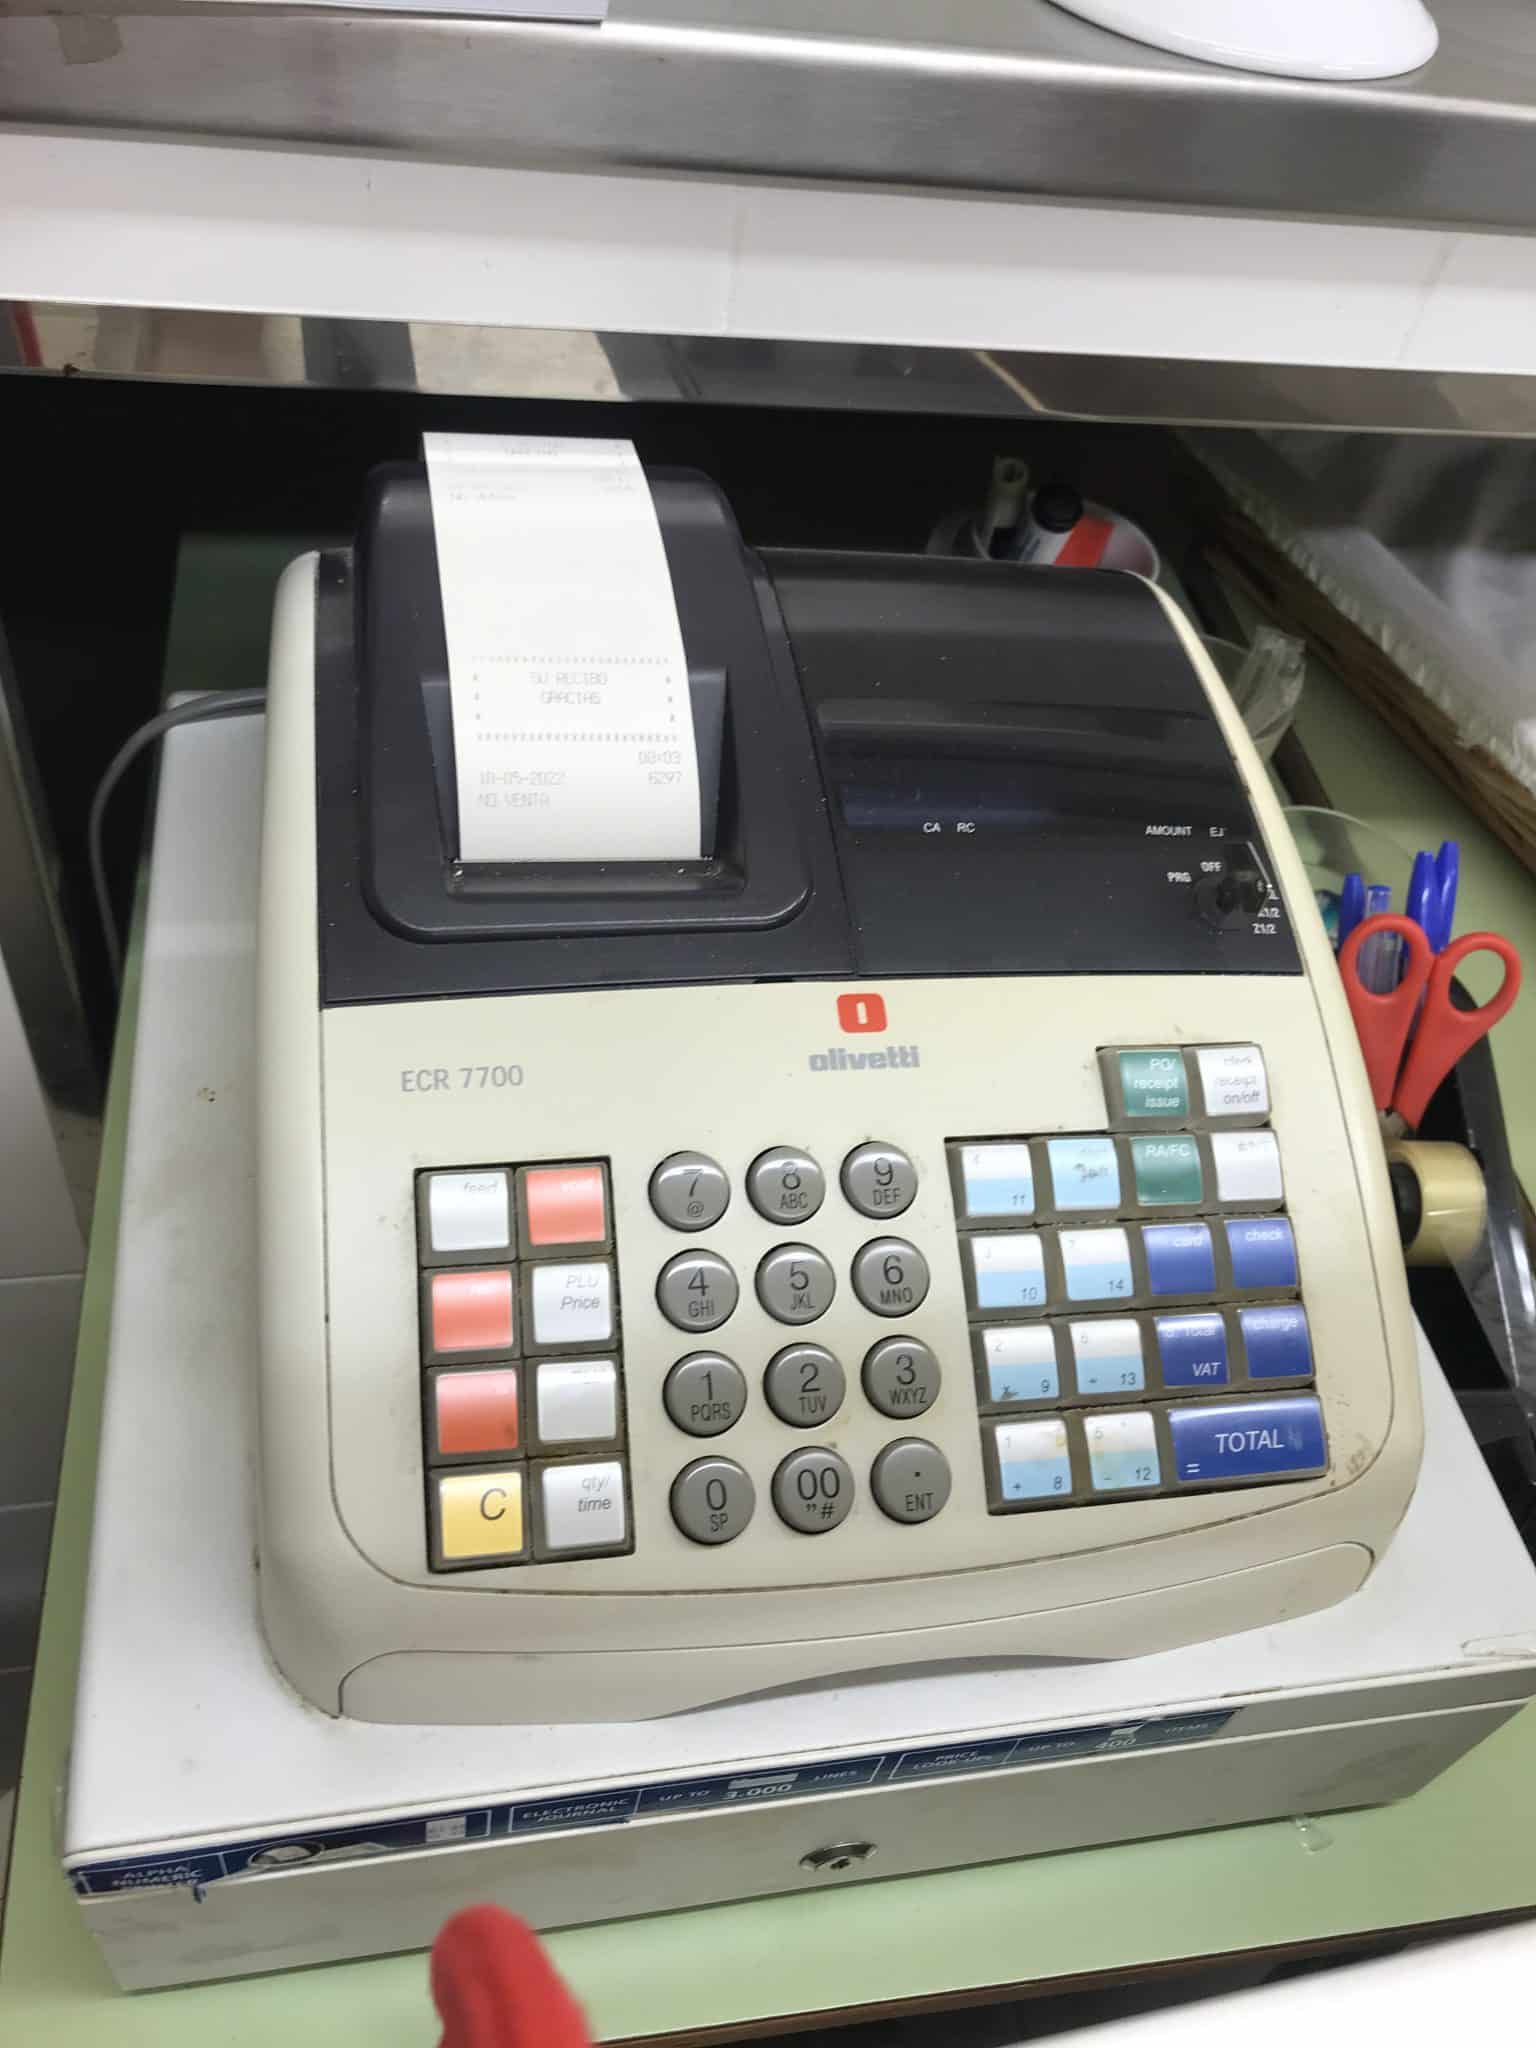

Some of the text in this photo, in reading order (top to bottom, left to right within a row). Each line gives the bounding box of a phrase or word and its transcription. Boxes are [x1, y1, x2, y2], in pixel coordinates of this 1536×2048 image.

[540, 690, 602, 704] GRACIAS
[923, 822, 976, 834] CA RC
[1145, 825, 1192, 838] AMOUNT
[1200, 861, 1222, 872] OFF
[1167, 871, 1192, 883] PRG
[809, 1045, 921, 1072] olivetti
[400, 1064, 524, 1092] ECR 7700
[1134, 1076, 1179, 1091] receipt
[1145, 1094, 1180, 1109] issue
[1223, 1090, 1261, 1105] on/off
[782, 1160, 802, 1190] 8
[873, 1157, 893, 1186] 9
[683, 1168, 703, 1198] 7
[780, 1192, 809, 1209] ABC
[873, 1188, 902, 1206] DEF
[1011, 1193, 1027, 1206] 11
[789, 1261, 810, 1291] 5
[883, 1254, 904, 1286] 6
[565, 1273, 600, 1289] PLU
[688, 1267, 710, 1297] 4
[1107, 1280, 1125, 1292] 14
[789, 1292, 815, 1310] JKL
[880, 1286, 914, 1306] MNO
[1020, 1286, 1038, 1301] 10
[560, 1295, 601, 1311] Price
[687, 1300, 715, 1318] GHI
[799, 1362, 820, 1394] 2
[895, 1354, 916, 1386] 3
[1191, 1361, 1221, 1377] VAT
[701, 1369, 713, 1401] 1
[1040, 1379, 1051, 1393] 9
[1119, 1371, 1137, 1386] 13
[889, 1387, 928, 1405] WXYZ
[690, 1402, 732, 1423] PQRS
[799, 1395, 828, 1416] TUV
[1095, 1426, 1105, 1440] 5
[1214, 1428, 1285, 1455] TOTAL
[1054, 1475, 1064, 1490] 8
[1135, 1467, 1152, 1481] 12
[797, 1467, 840, 1500] 00
[577, 1493, 612, 1513] time
[706, 1478, 727, 1511] 0
[905, 1494, 933, 1512] ENT
[480, 1486, 507, 1522] C
[711, 1513, 729, 1533] SP
[1096, 1736, 1137, 1750] 400
[522, 1797, 630, 1820] ELECTRONIC
[111, 1869, 201, 1887] NUMERIC
[123, 1864, 192, 1881] ALPHA
